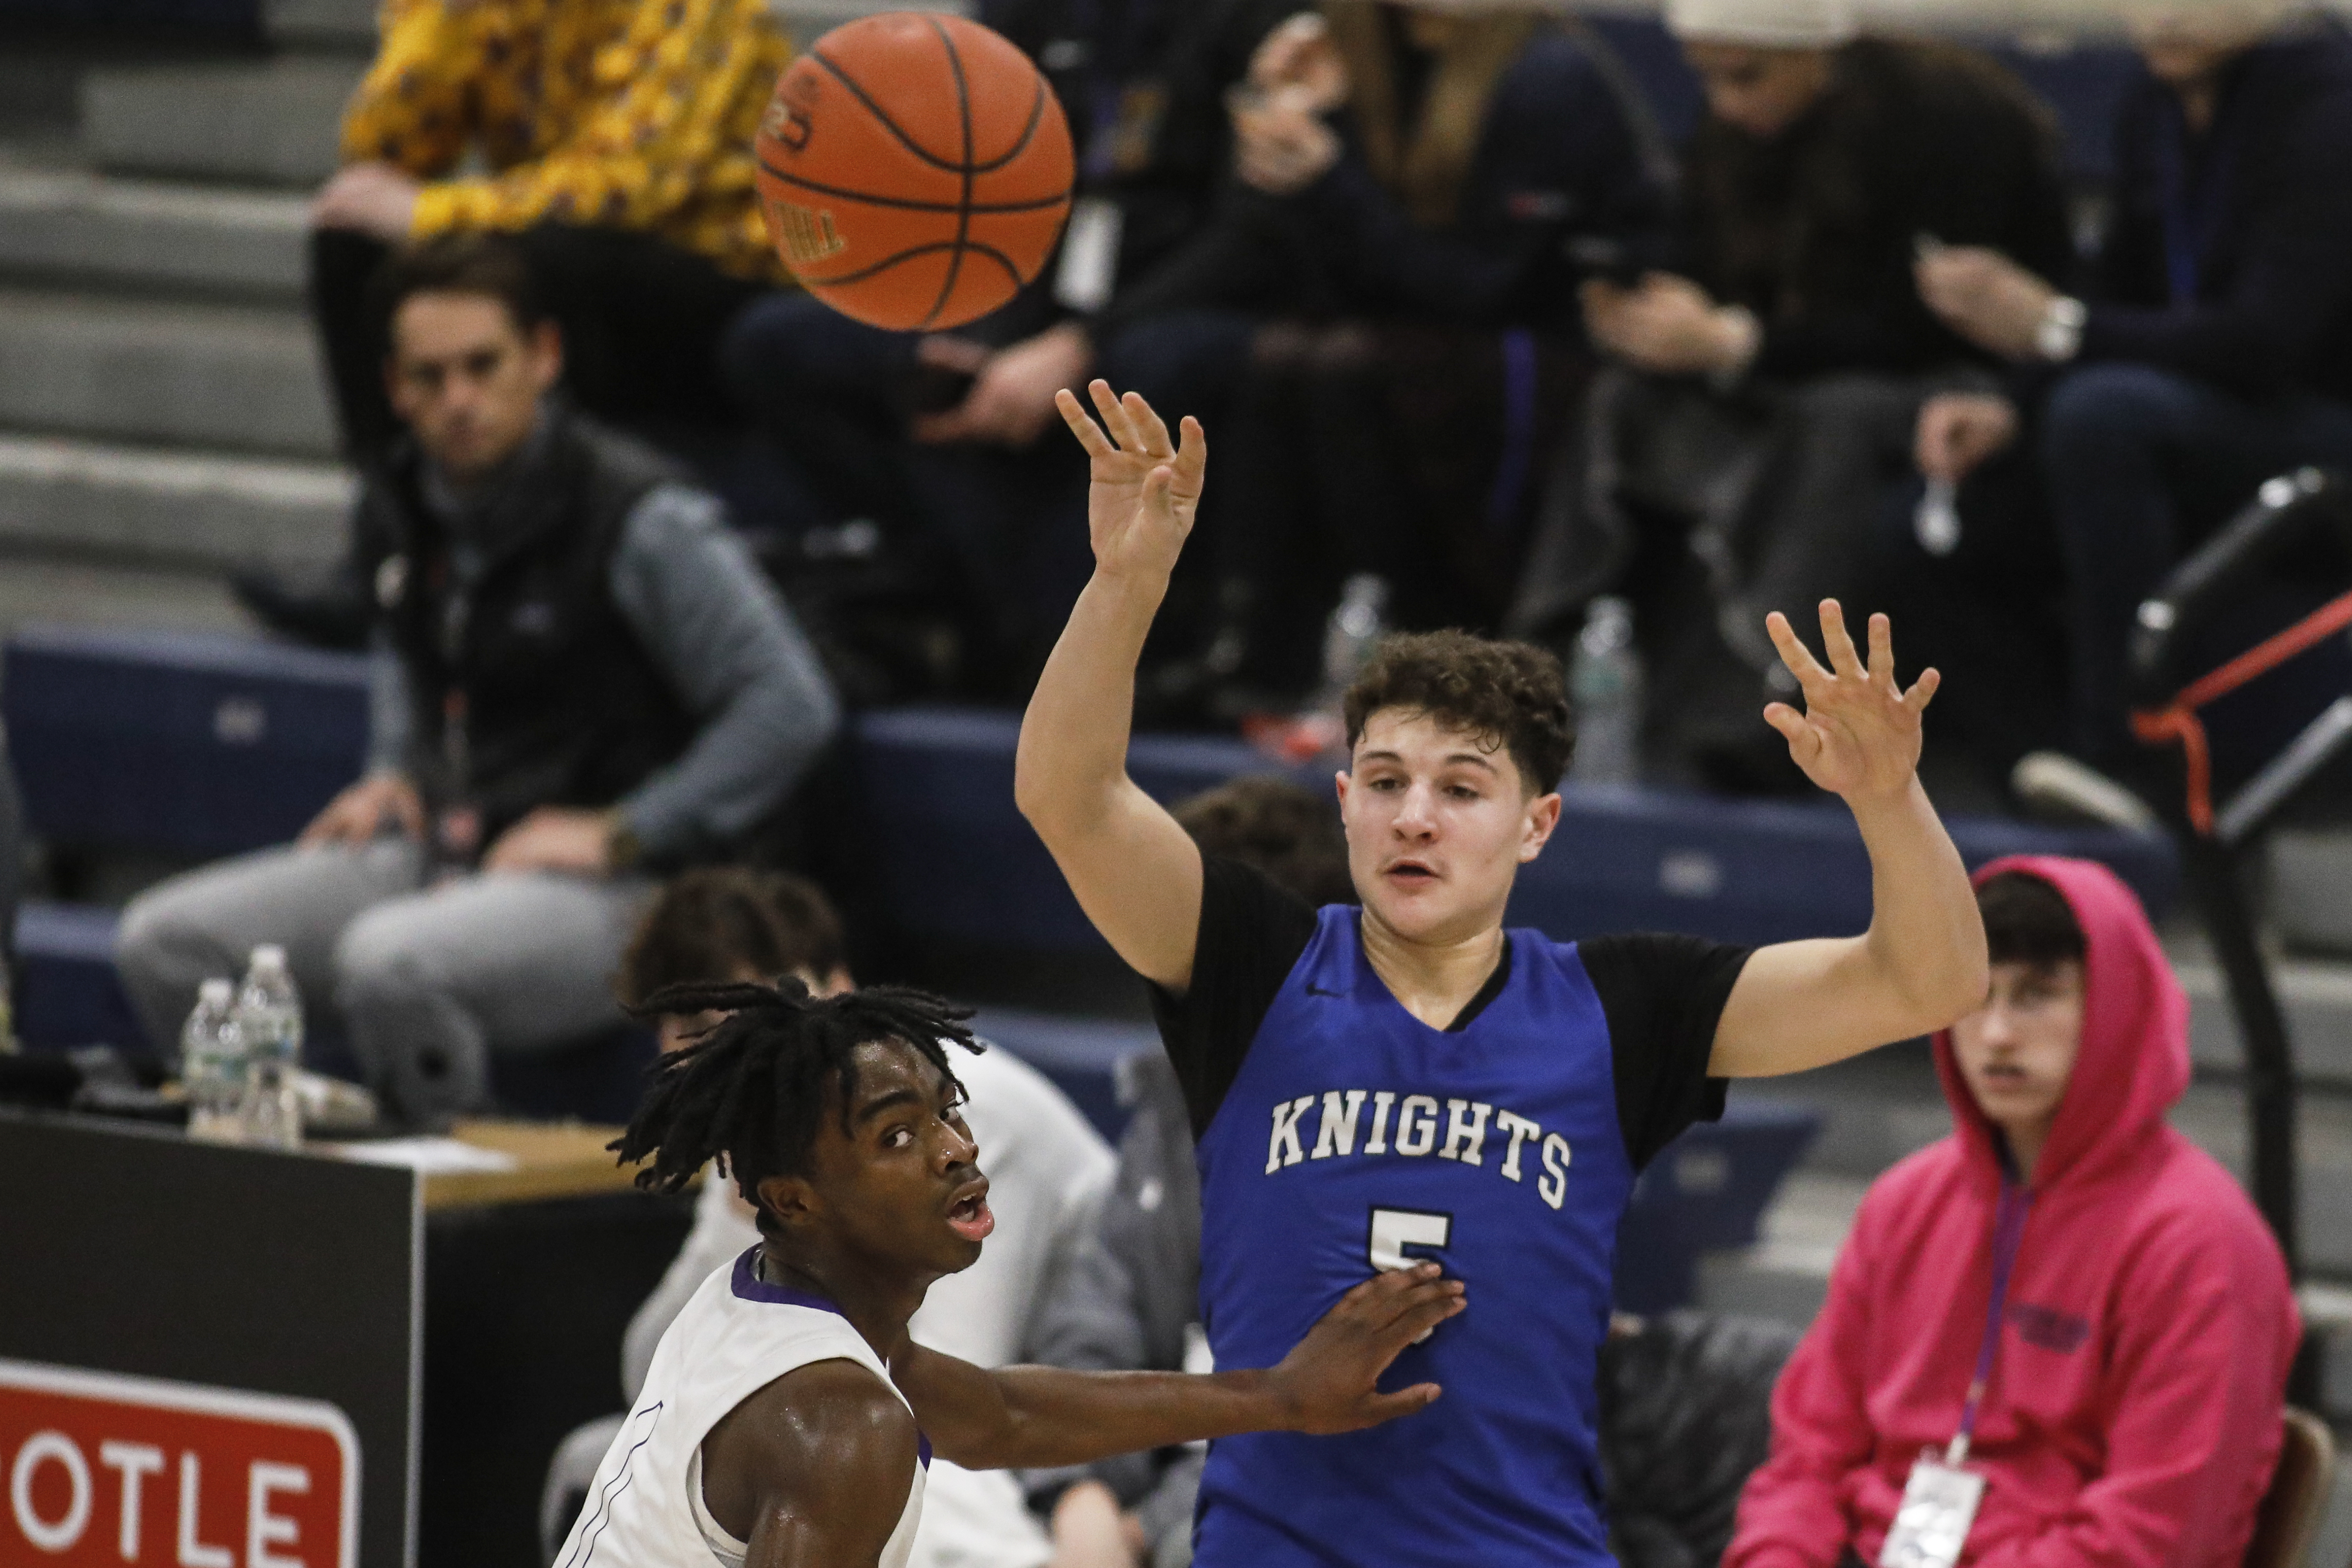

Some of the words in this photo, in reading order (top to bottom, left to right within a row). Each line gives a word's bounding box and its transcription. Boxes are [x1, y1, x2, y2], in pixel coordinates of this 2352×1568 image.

[1265, 1088, 1573, 1210] KNIGHTS
[1369, 1205, 1453, 1345] 5
[0, 1428, 312, 1568] OTLE
